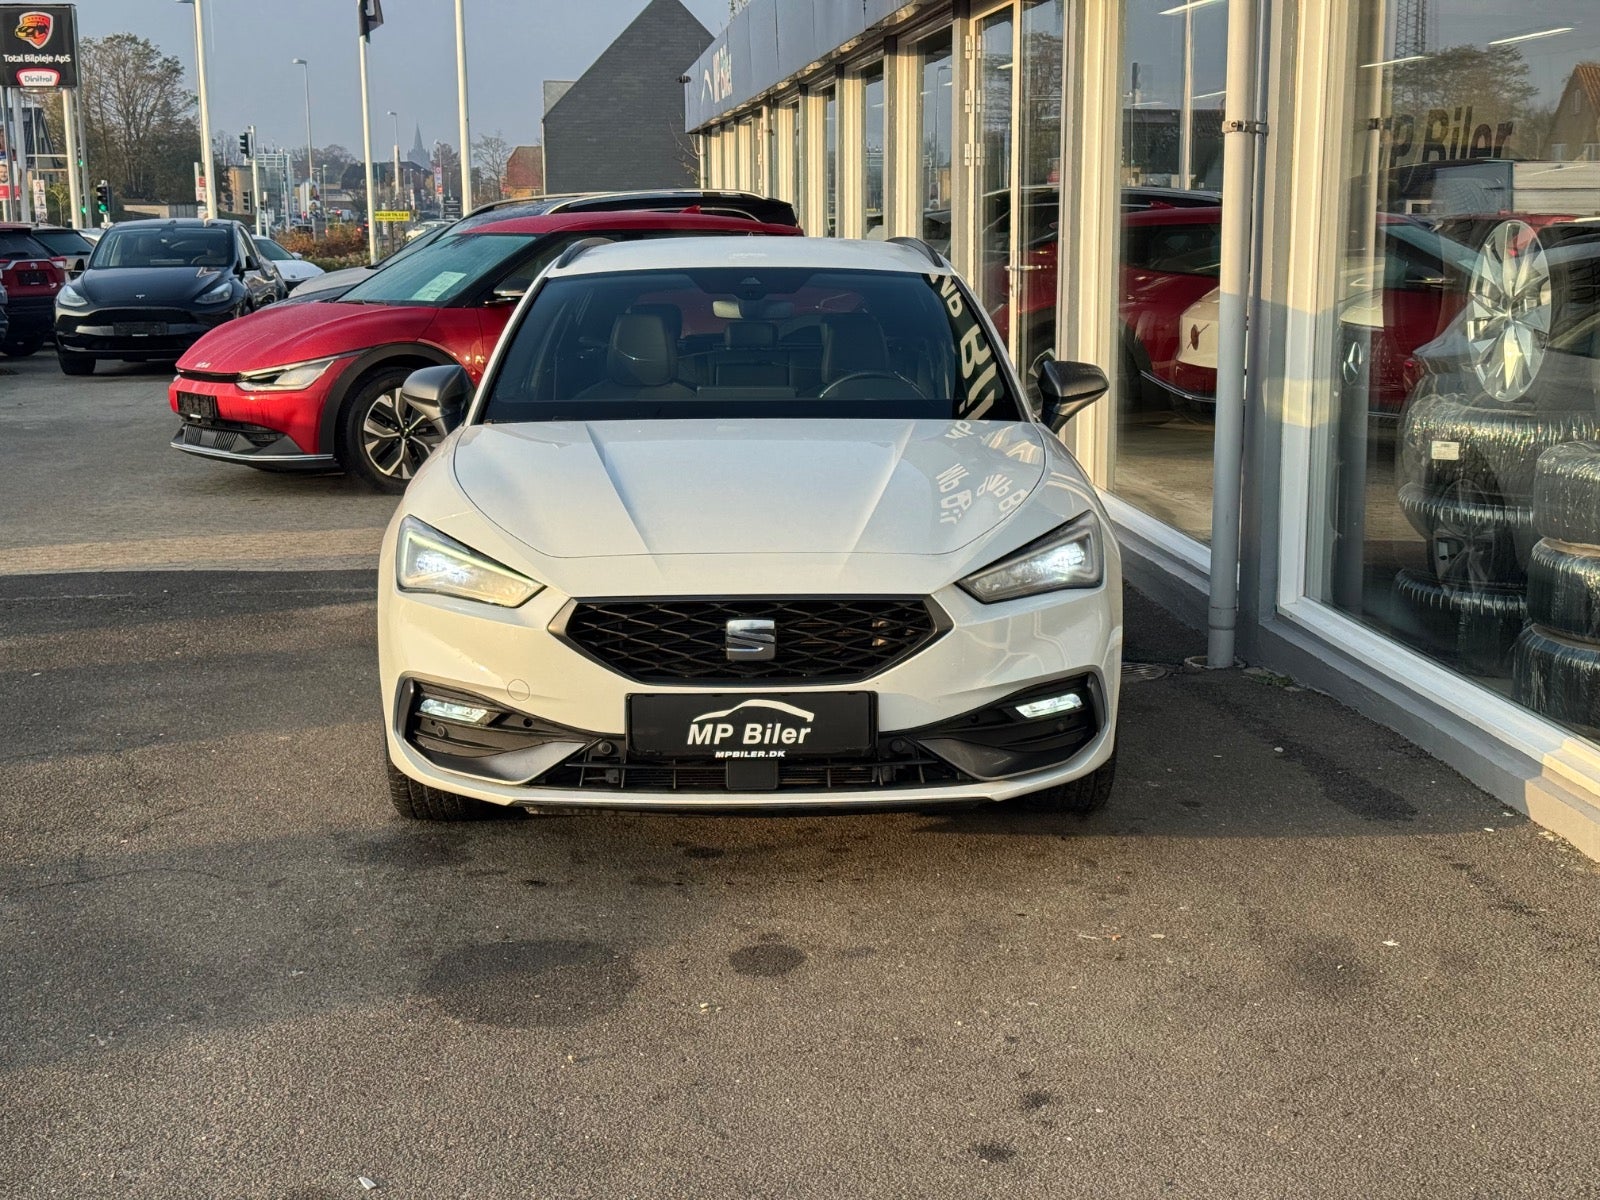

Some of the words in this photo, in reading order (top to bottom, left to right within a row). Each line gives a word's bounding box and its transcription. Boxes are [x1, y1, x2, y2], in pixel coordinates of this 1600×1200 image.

[3, 54, 24, 63] Total
[24, 53, 54, 64] Bilpleje
[54, 54, 71, 64] ApS
[24, 75, 53, 83] Dinitrol
[687, 723, 734, 745] MP
[742, 723, 811, 745] Biler
[715, 750, 786, 758] MPBILER.DK
